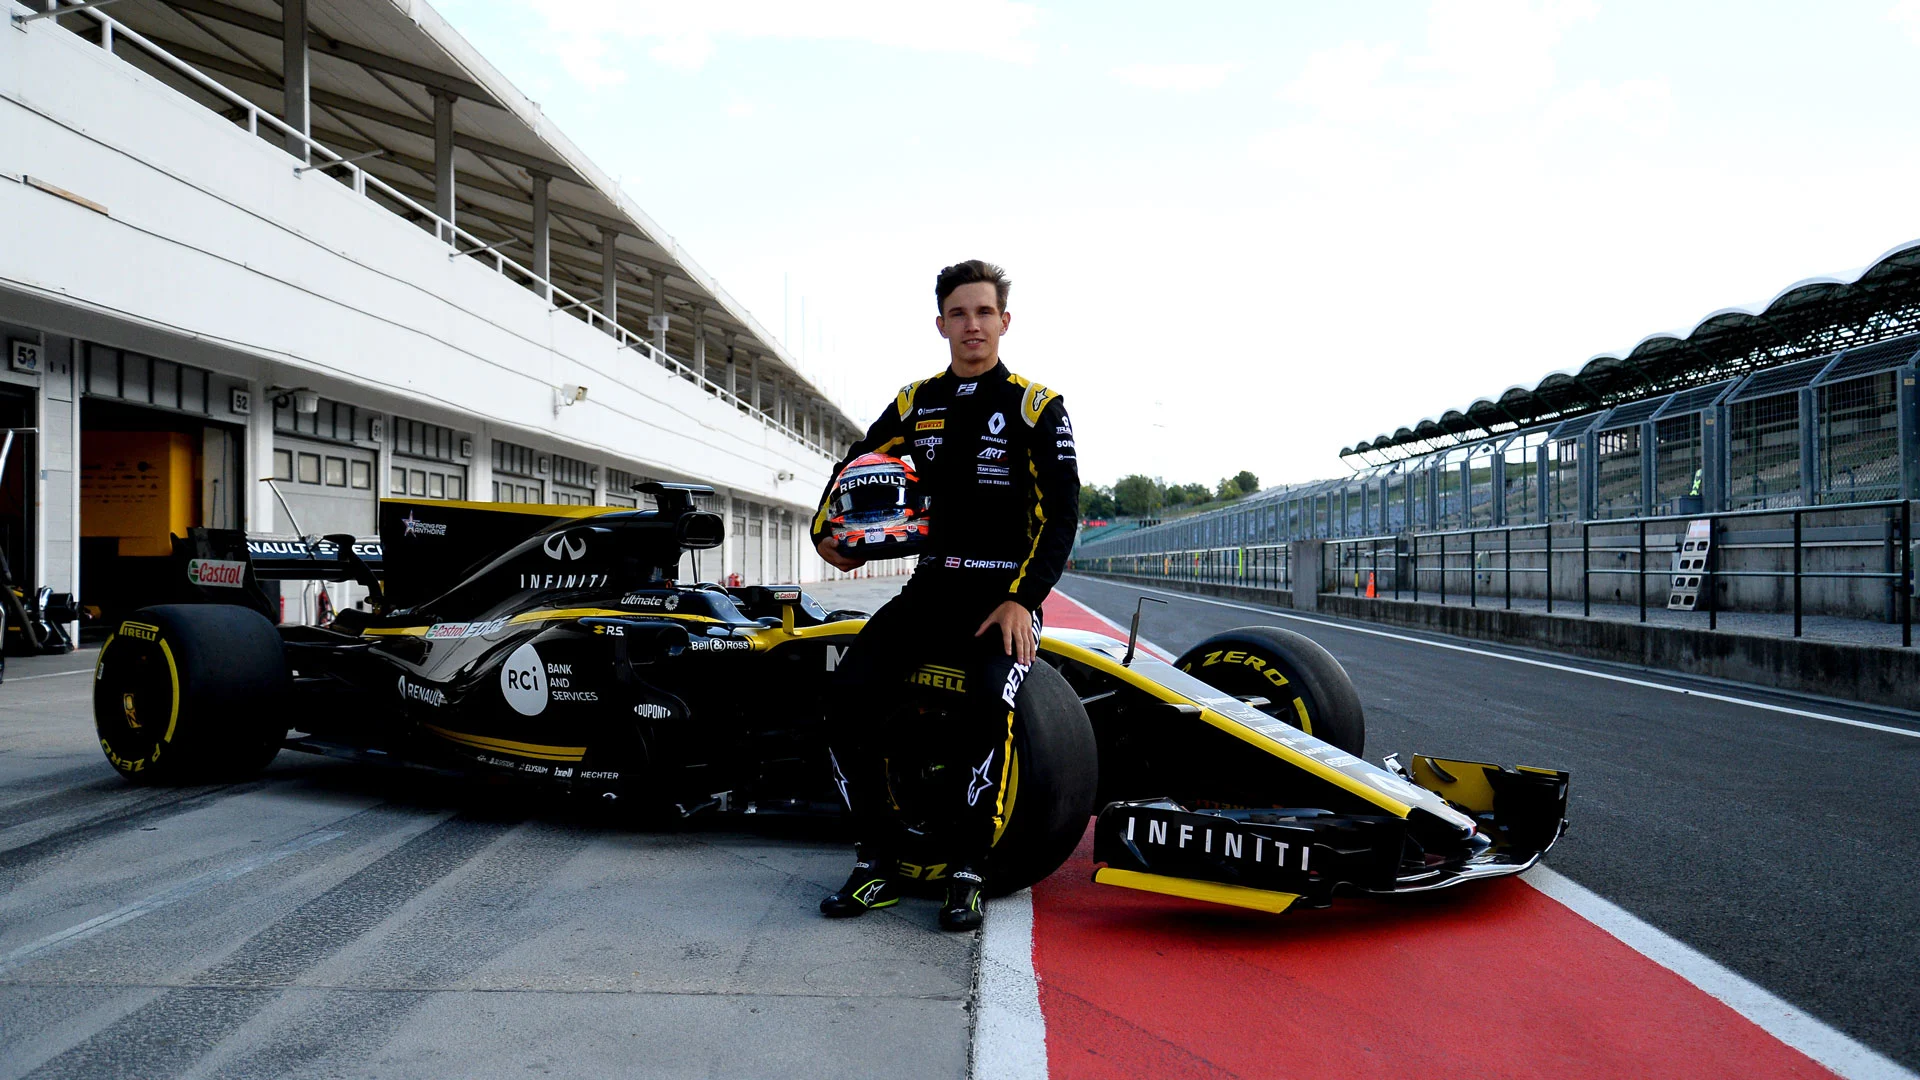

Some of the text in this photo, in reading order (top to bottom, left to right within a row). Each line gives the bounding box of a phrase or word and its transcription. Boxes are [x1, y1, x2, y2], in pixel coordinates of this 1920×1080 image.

[957, 381, 978, 394] F3
[235, 394, 248, 410] 52
[980, 435, 1008, 446] RENAULT
[978, 447, 1007, 460] ART
[839, 474, 906, 495] RENAULT
[246, 541, 307, 555] NAULT
[963, 558, 1019, 570] CHRISTIAN
[199, 562, 242, 585] Castrol
[520, 573, 609, 589] INFINITI
[620, 594, 662, 607] ultimate
[118, 619, 160, 642] PIRELLI
[434, 624, 467, 638] Castrol
[691, 640, 709, 651] Bell
[727, 640, 749, 651] Ross
[547, 663, 573, 676] BANK
[1201, 649, 1290, 687] ZERO
[550, 678, 570, 689] AND
[407, 682, 443, 709] RENAULT
[551, 692, 599, 703] SERVICES
[637, 703, 668, 719] DUPONT
[524, 763, 549, 775] ELYSIUM
[580, 770, 620, 780] HECHTER
[1126, 815, 1311, 872] INFINITI
